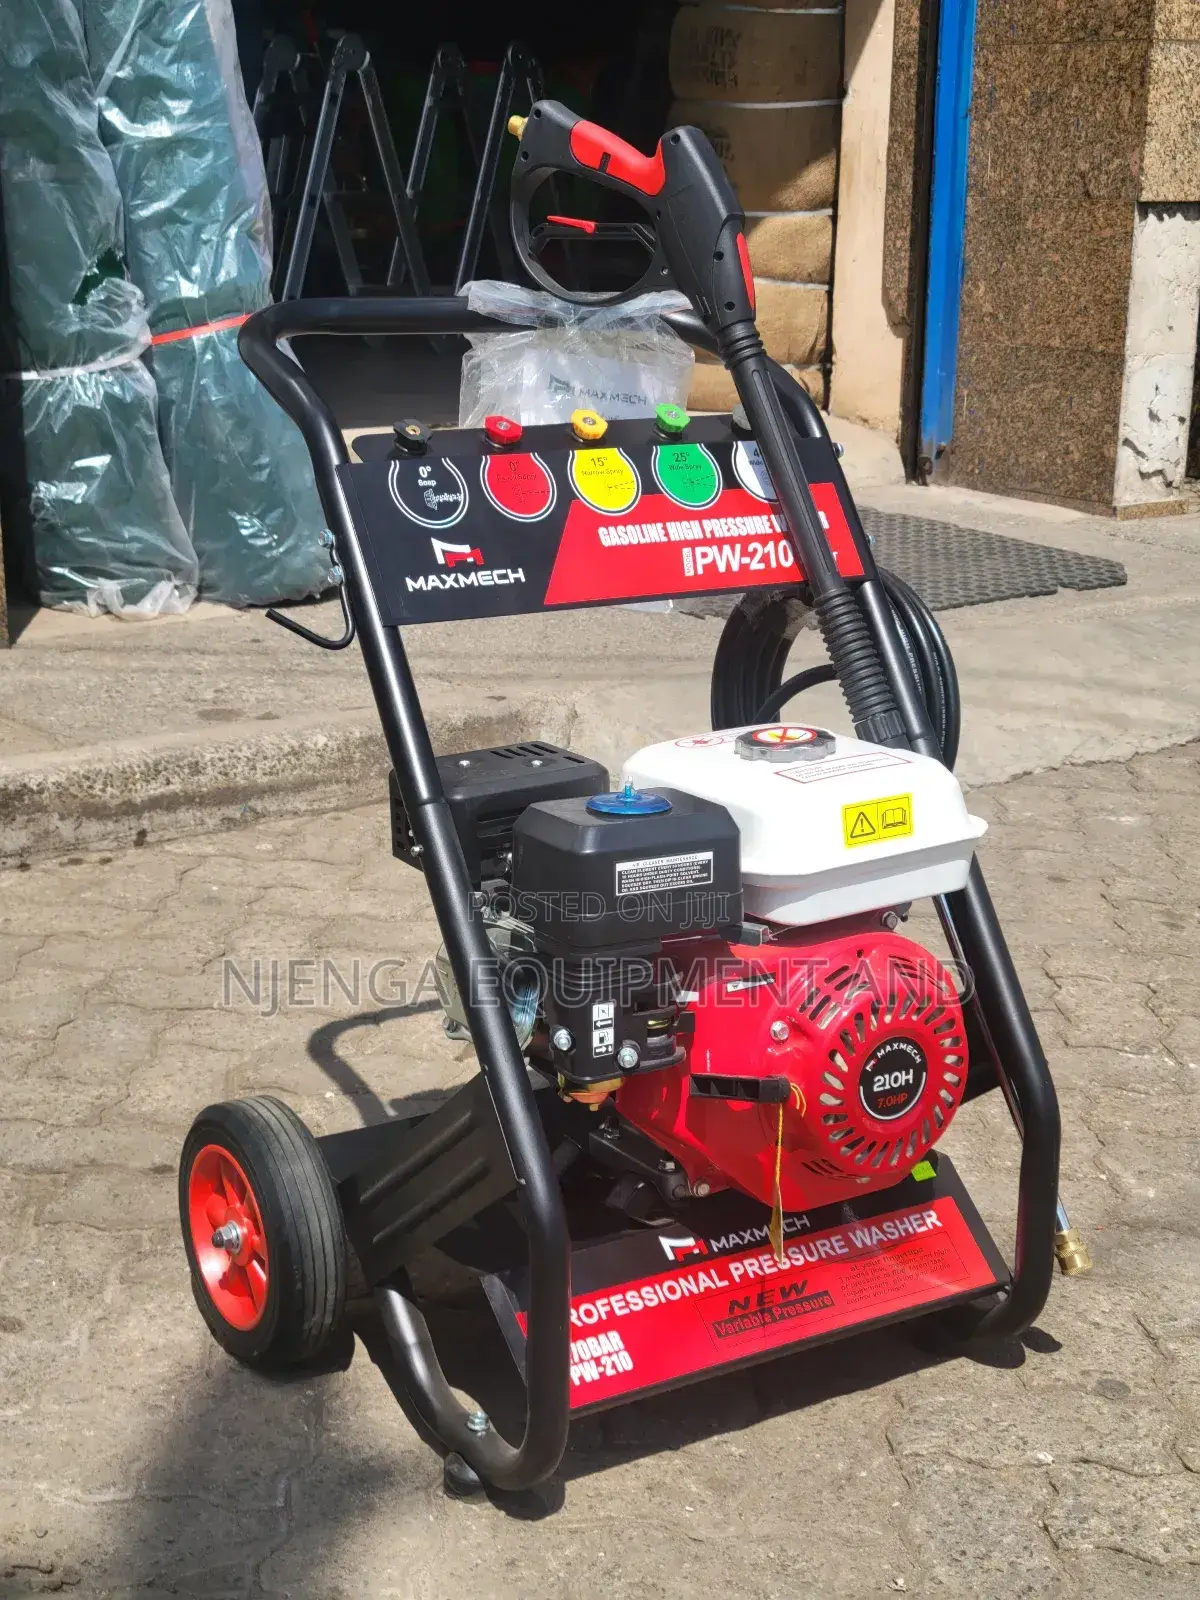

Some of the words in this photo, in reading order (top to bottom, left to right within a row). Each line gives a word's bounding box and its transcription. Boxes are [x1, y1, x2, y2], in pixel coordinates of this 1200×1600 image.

[579, 387, 647, 405] MAXMECH
[591, 457, 608, 467] 15°
[673, 451, 691, 463] 25°
[417, 479, 437, 487] Soap
[598, 523, 668, 547] GASOLINE
[667, 519, 702, 542] HIGH
[702, 514, 774, 539] PRESSURE
[405, 567, 526, 592] MAXMECH
[876, 1042, 922, 1064] MAXMECH
[873, 1069, 914, 1092] 210H
[877, 1092, 908, 1108] 7.0HP
[709, 1214, 811, 1252] MAXMCH
[571, 1269, 730, 1327] ROFESSIONAL
[728, 1235, 849, 1283] PRESSURE
[848, 1209, 943, 1249] WASHER
[727, 1279, 809, 1316] NEW
[715, 1310, 772, 1338] Variable
[773, 1293, 833, 1322] Pressure
[571, 1350, 634, 1386] PW-210
